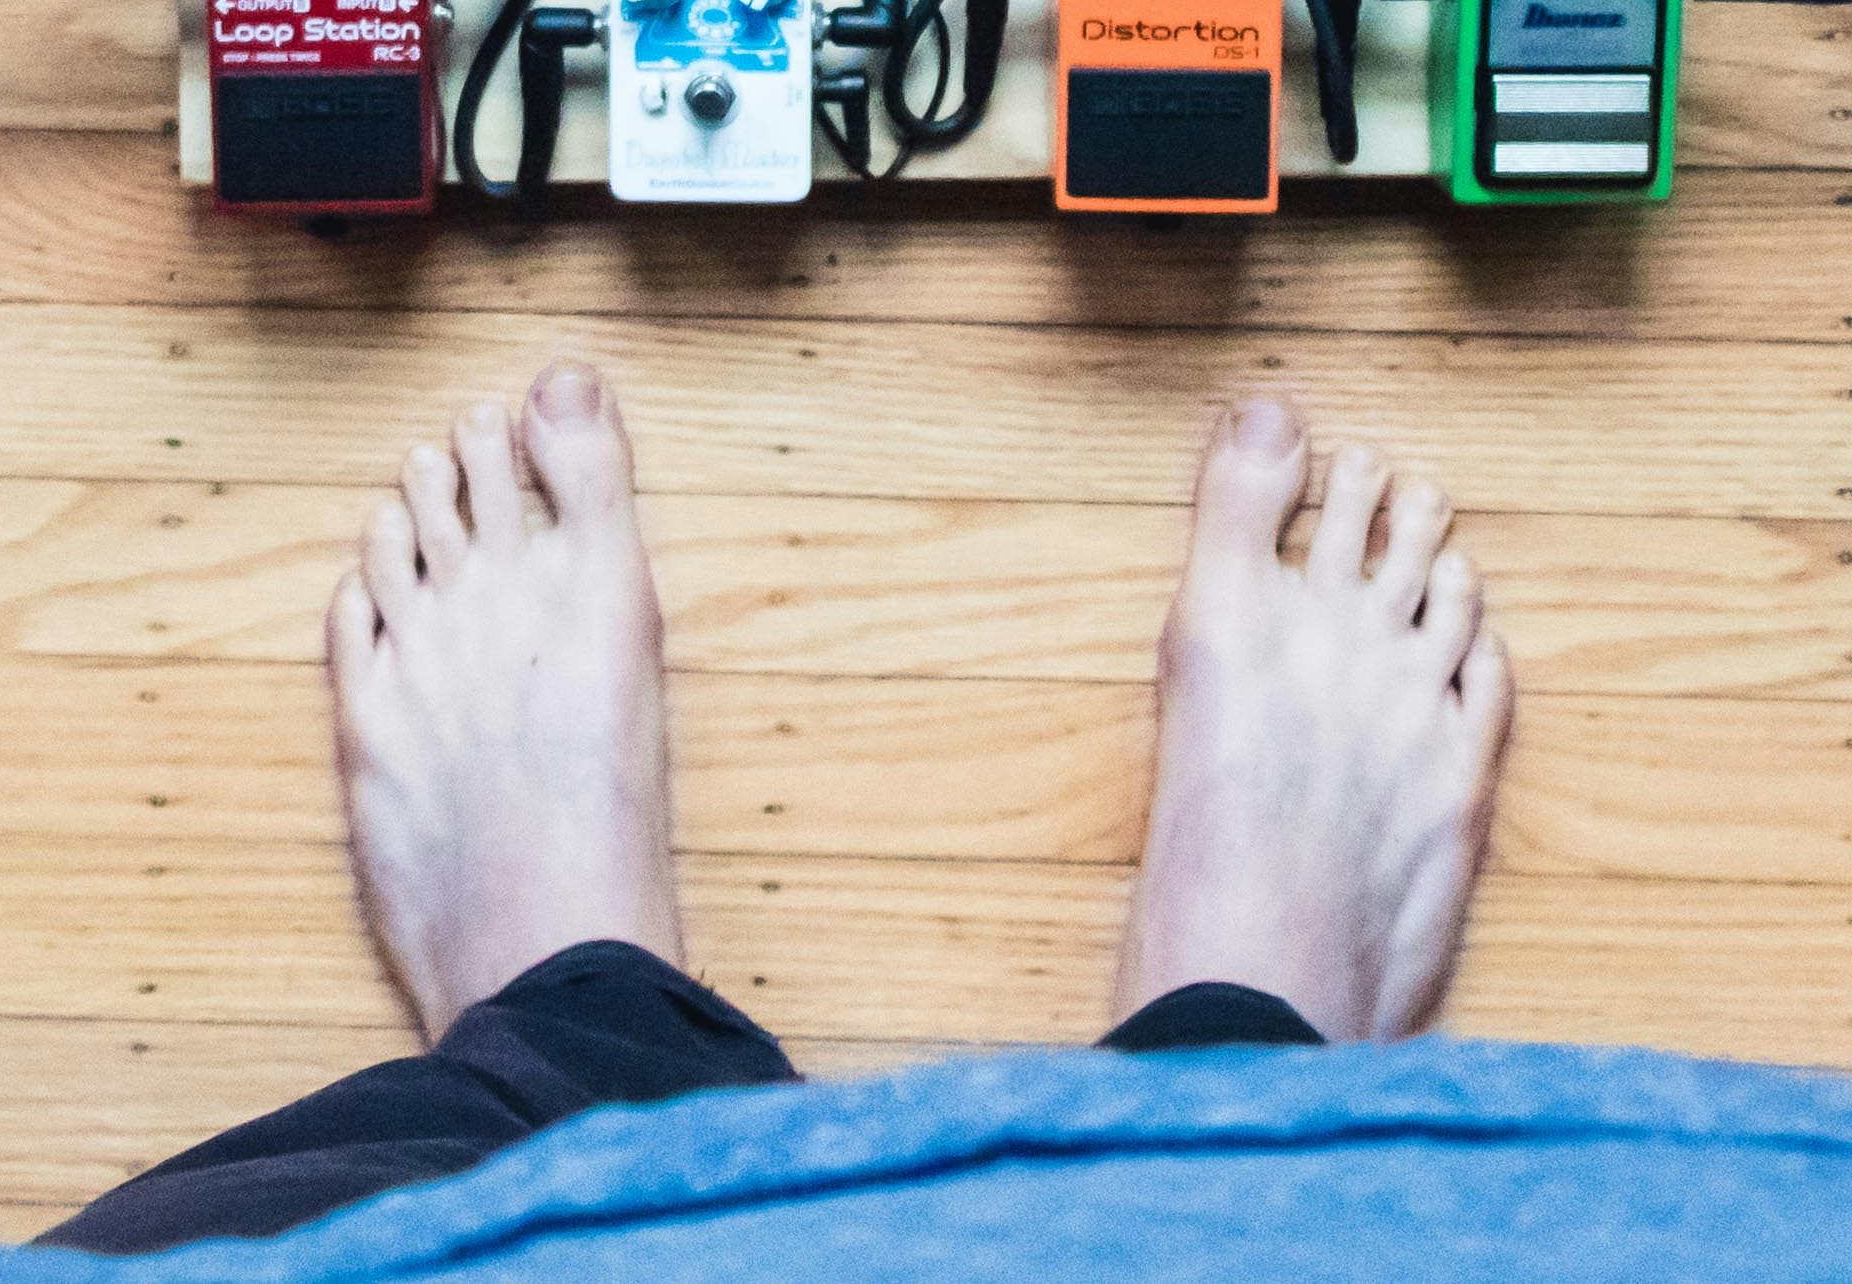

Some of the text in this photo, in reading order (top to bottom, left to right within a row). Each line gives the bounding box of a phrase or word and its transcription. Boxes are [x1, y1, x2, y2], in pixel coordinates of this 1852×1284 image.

[214, 18, 421, 48] Loop Station
[1082, 19, 1260, 42] Distortion
[1213, 45, 1260, 60] DS-1
